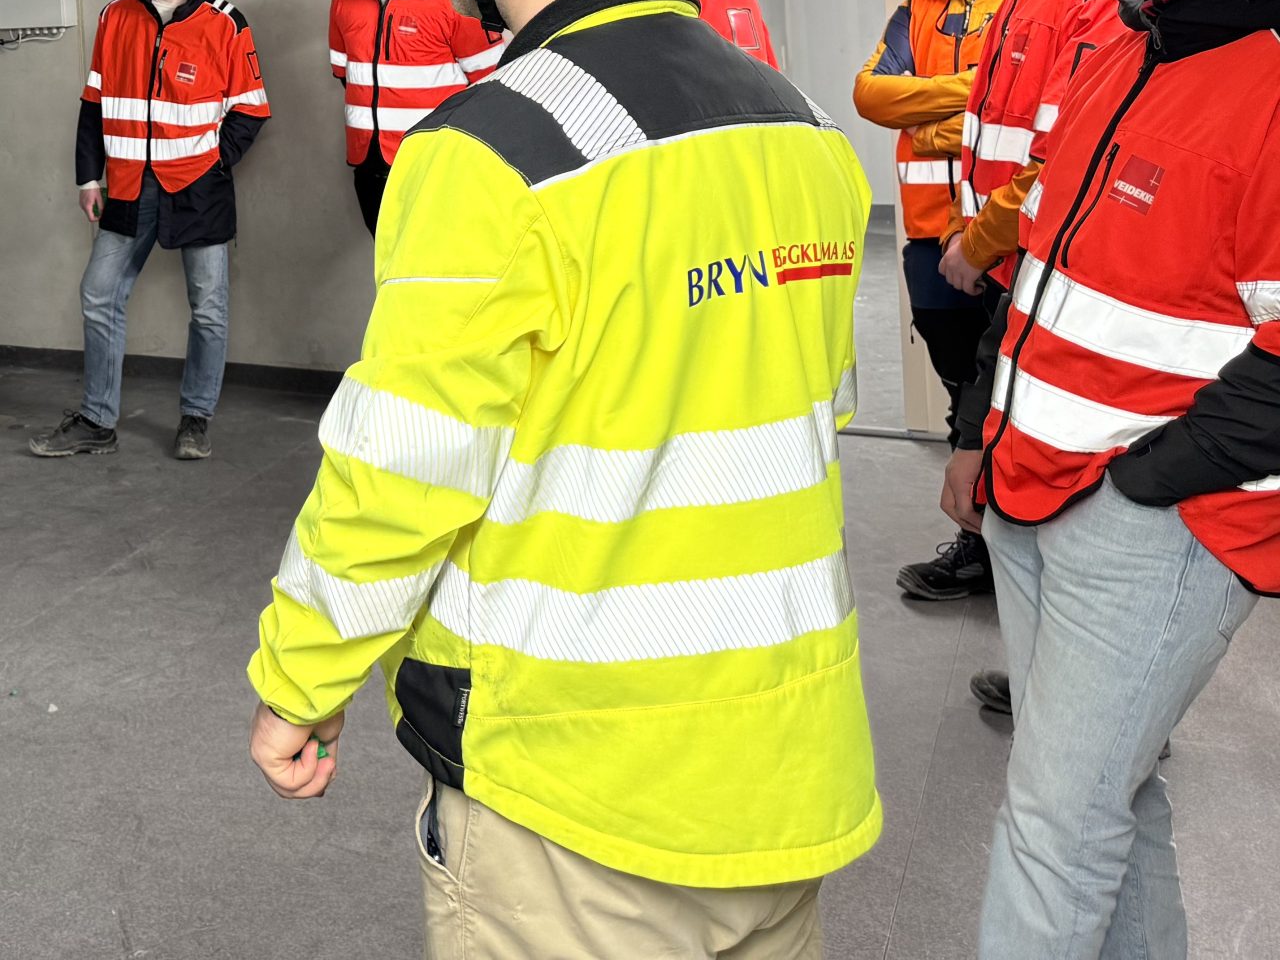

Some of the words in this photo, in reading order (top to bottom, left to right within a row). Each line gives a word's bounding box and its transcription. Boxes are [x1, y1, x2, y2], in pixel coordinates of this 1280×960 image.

[1113, 178, 1155, 205] VEIDEKKE
[687, 250, 769, 308] BRYN
[841, 240, 856, 261] AS
